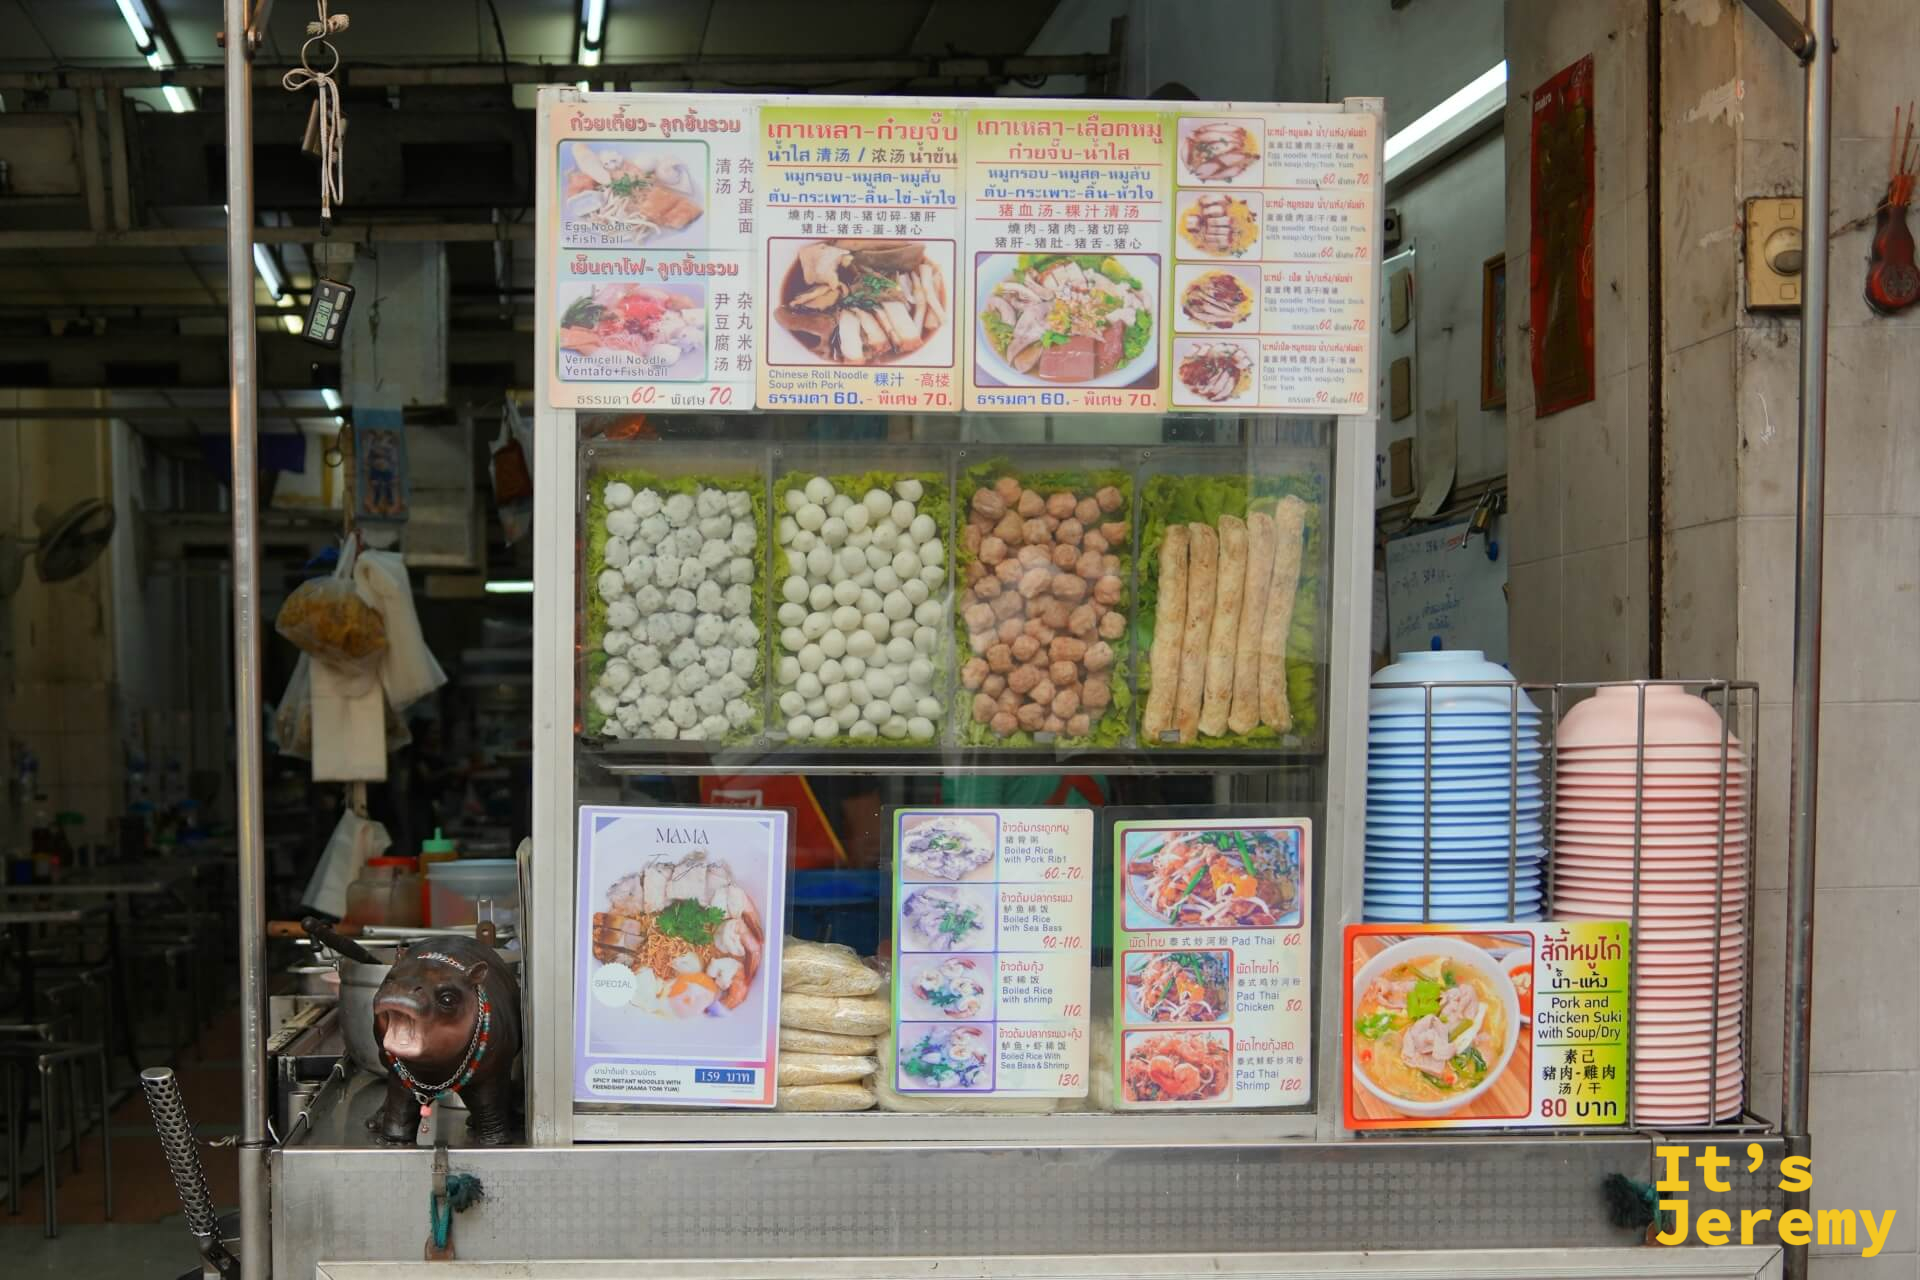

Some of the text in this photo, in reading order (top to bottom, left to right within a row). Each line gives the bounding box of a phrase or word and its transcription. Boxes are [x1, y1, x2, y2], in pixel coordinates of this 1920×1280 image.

[716, 158, 731, 194] 清汤
[565, 222, 587, 233] Egg
[601, 234, 624, 244] Ball
[565, 355, 667, 365] Vermicelli Noodle
[768, 369, 808, 379] Chinese
[811, 370, 830, 379] Roll
[833, 370, 868, 380] Noodle
[768, 380, 844, 390] Soup with Pork
[656, 827, 709, 845] MAMA
[1004, 847, 1053, 855] Boiled Rice
[1004, 855, 1022, 863] with
[1003, 915, 1051, 923] Boiled Rice
[1003, 924, 1019, 932] with
[1232, 937, 1250, 945] Pad
[1254, 936, 1275, 945] Thai
[1552, 968, 1608, 989] น้ำ-แห้ง
[1002, 987, 1053, 995] Boiled Rice
[1236, 991, 1280, 1001] Pad Thai
[1002, 995, 1053, 1005] with shrimp
[1551, 996, 1609, 1009] Pork and
[1236, 1002, 1275, 1012] Chicken
[1538, 1010, 1622, 1024] Chicken Suki
[1538, 1025, 1621, 1041] with Soup/Dry
[1001, 1061, 1015, 1070] Sea
[1043, 1062, 1070, 1071] Shrimp
[701, 1071, 751, 1084] 159 บาท
[1236, 1069, 1279, 1079] Pad Thai
[1236, 1080, 1270, 1092] Shrimp
[1541, 1098, 1617, 1118] 80 บาท
